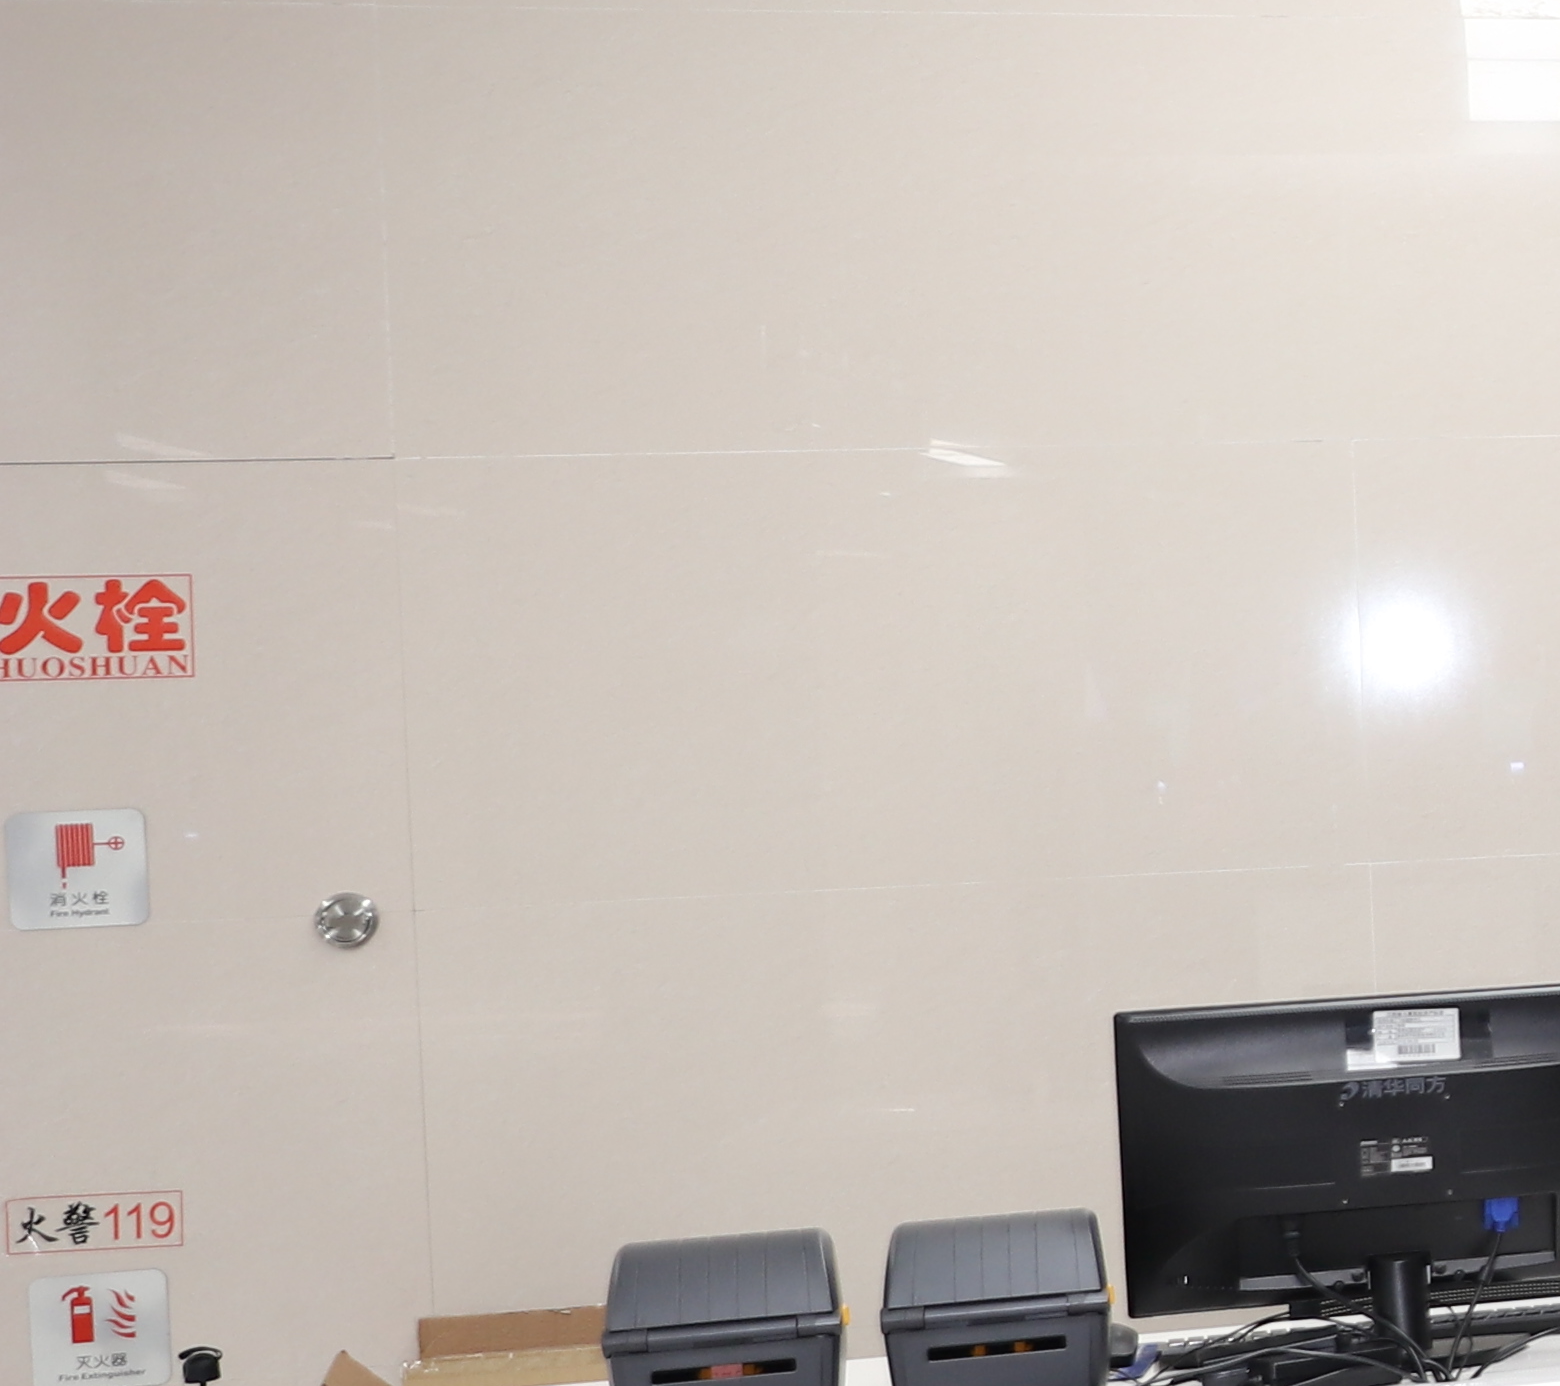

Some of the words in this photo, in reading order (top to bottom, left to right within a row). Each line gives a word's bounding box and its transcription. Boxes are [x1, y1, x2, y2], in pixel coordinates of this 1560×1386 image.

[0, 579, 186, 655] 火栓
[50, 891, 109, 906] 消火栓
[1362, 1076, 1446, 1098] 清华同方
[76, 1352, 127, 1370] 灭火器
